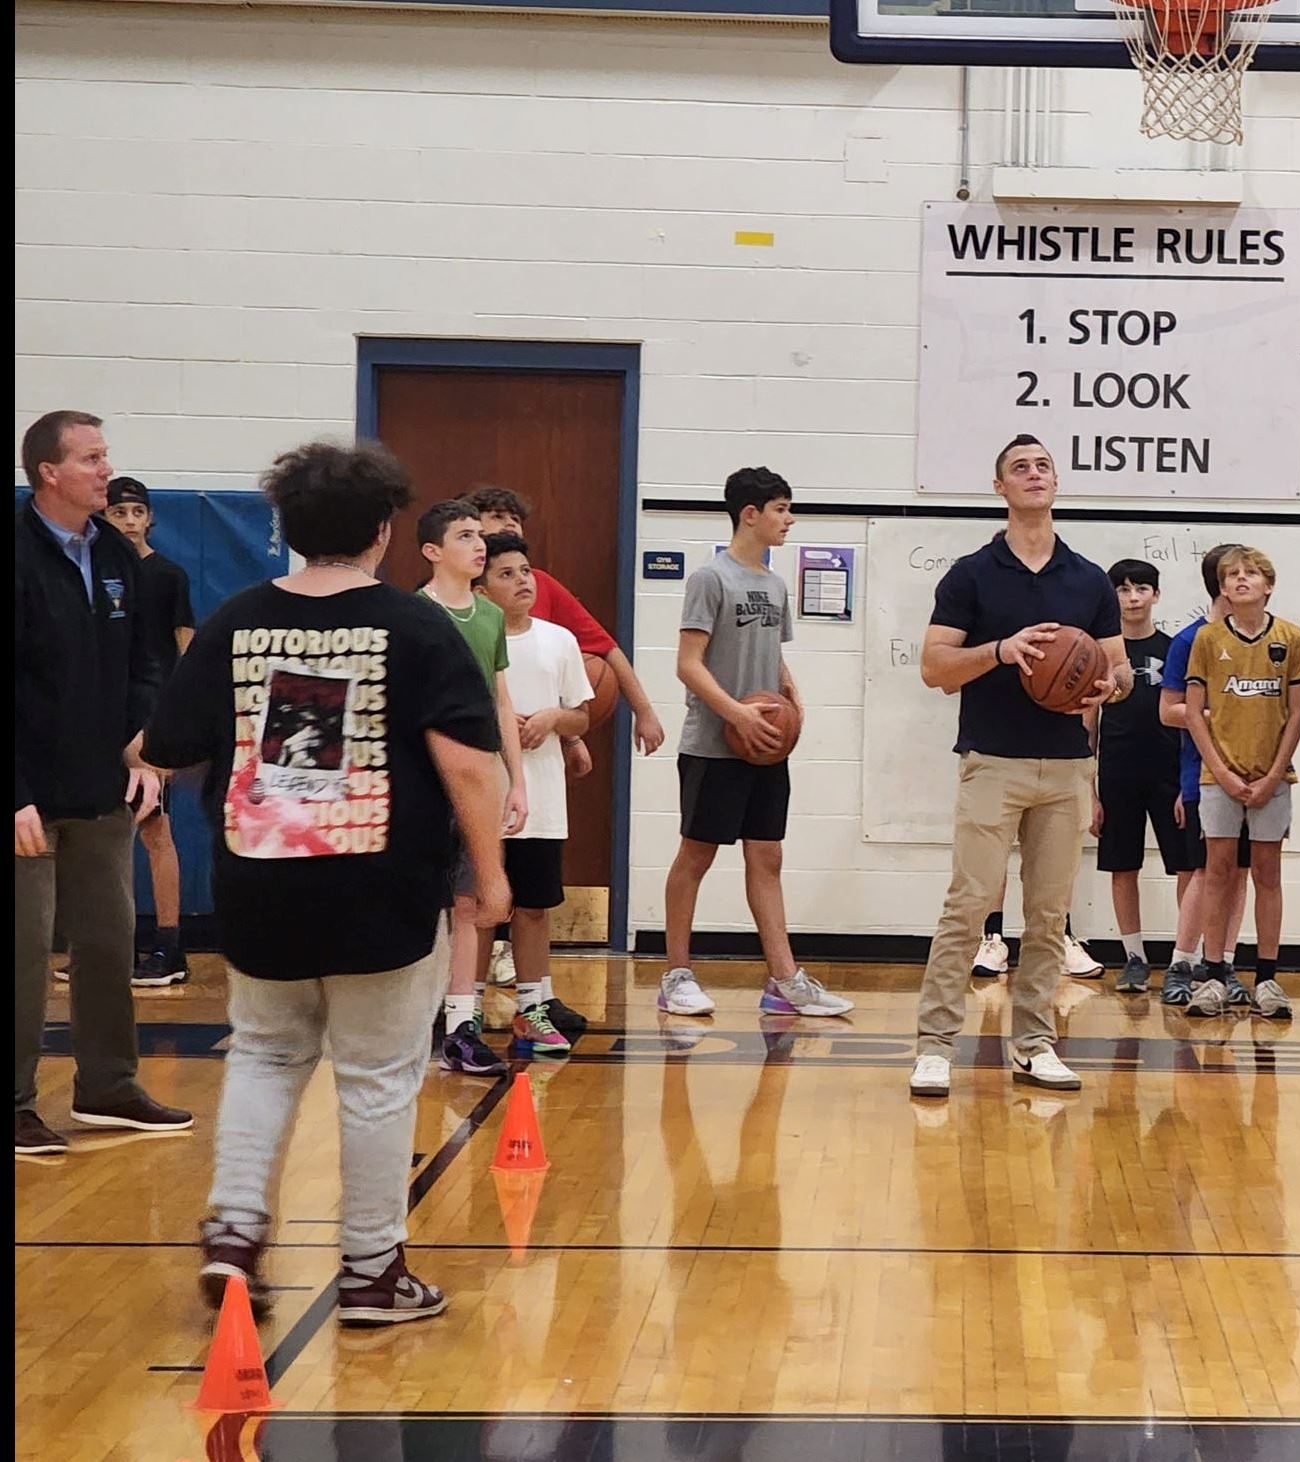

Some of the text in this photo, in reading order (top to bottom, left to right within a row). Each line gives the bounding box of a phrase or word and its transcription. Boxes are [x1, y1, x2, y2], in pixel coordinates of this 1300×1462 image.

[947, 224, 1285, 265] WHISTLE RULES
[1018, 309, 1177, 346] 1. STOP
[1016, 371, 1191, 409] 2. LOOK
[1071, 435, 1210, 474] LISTEN
[1143, 535, 1178, 562] Fail
[232, 627, 390, 655] NOTORIOUS
